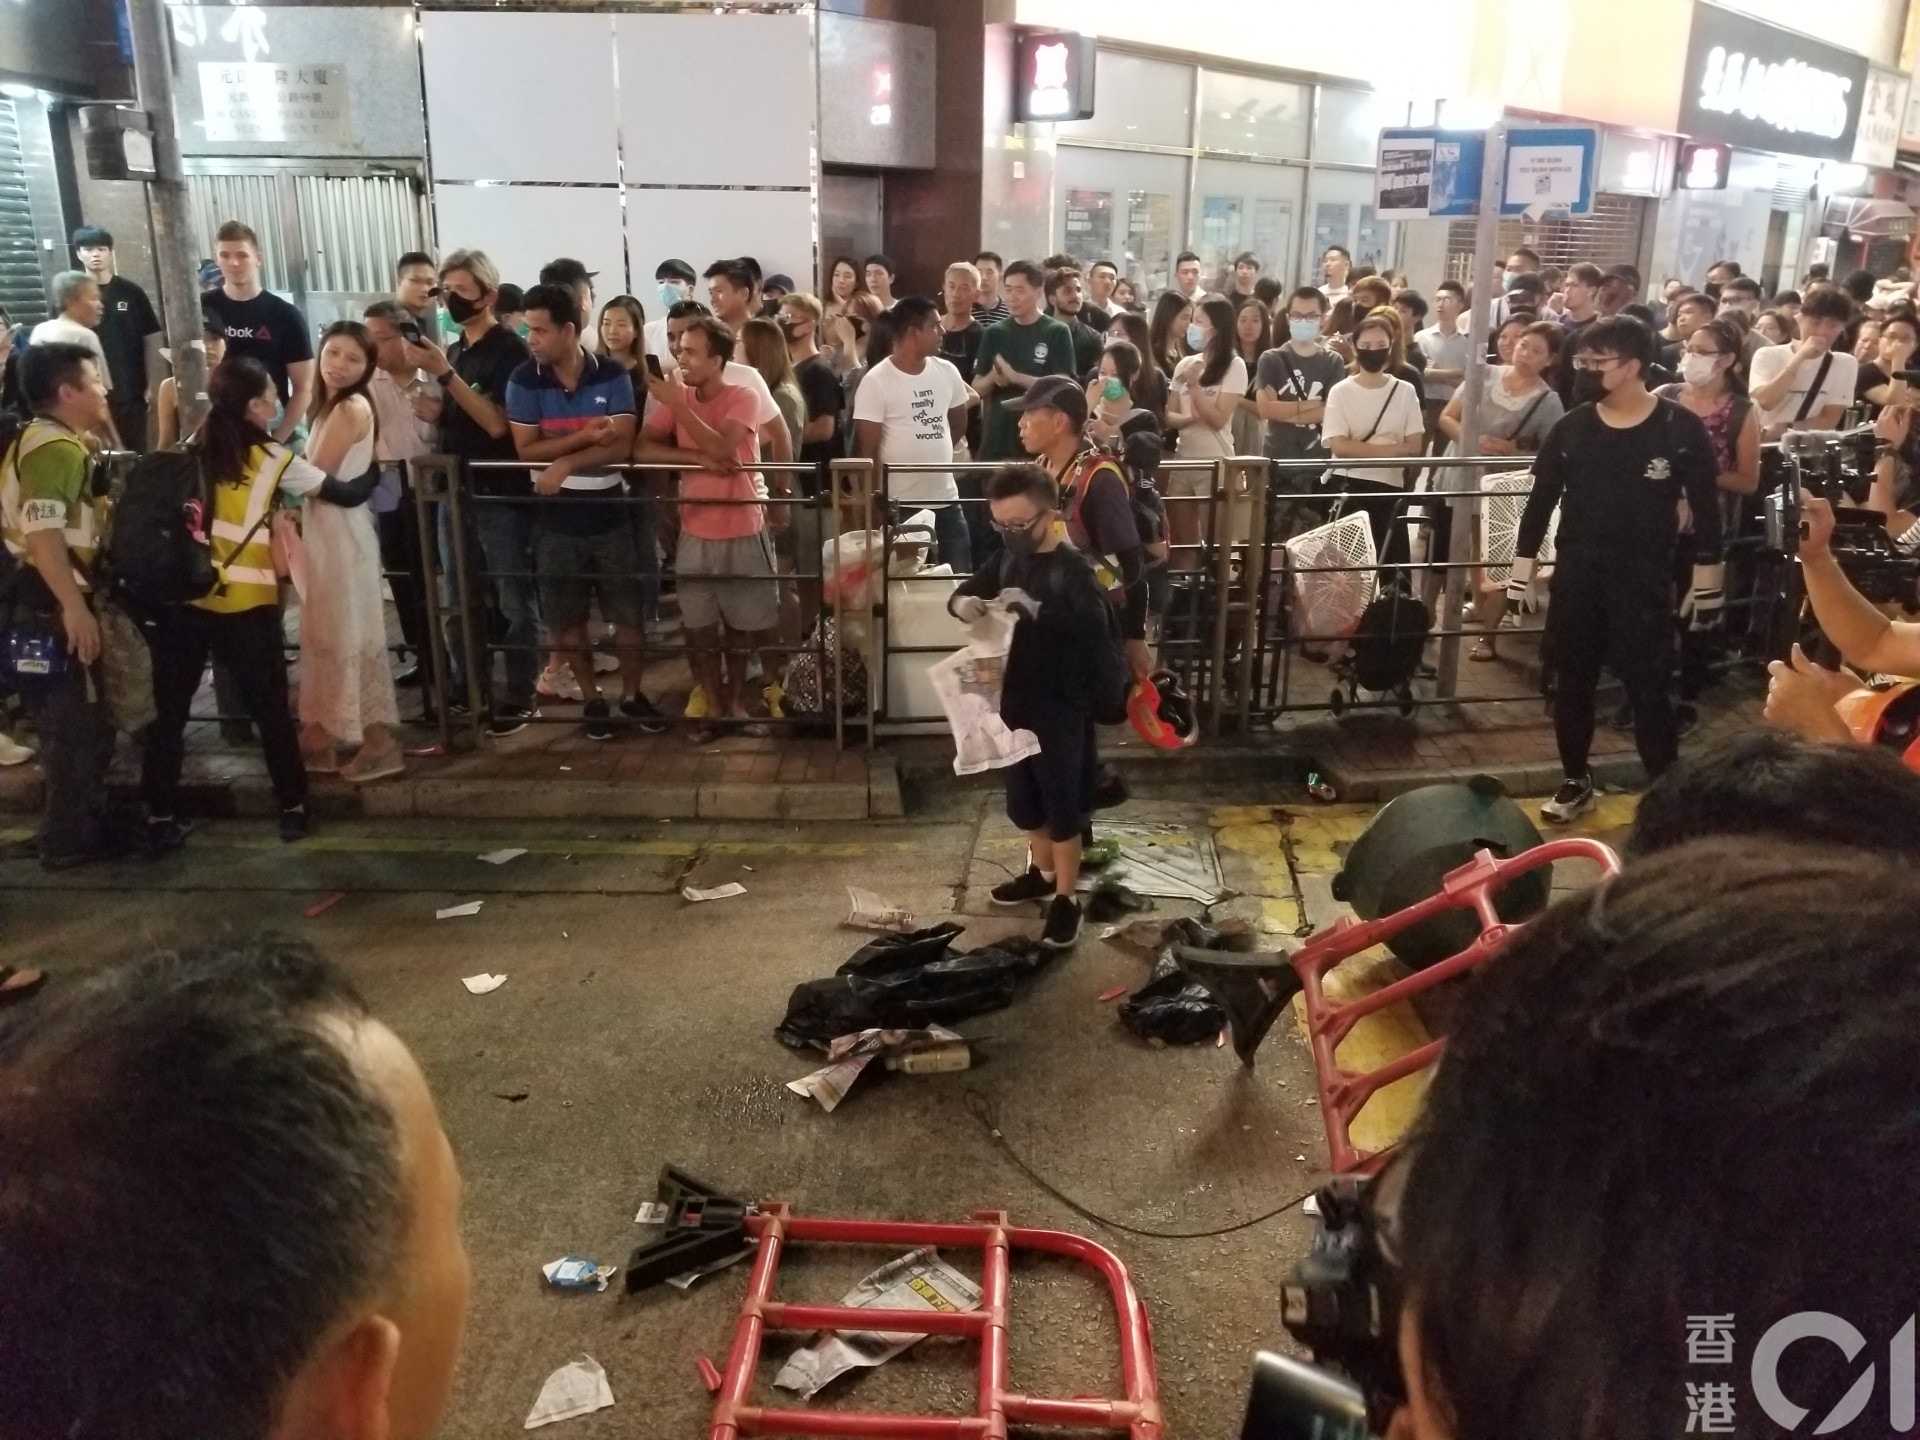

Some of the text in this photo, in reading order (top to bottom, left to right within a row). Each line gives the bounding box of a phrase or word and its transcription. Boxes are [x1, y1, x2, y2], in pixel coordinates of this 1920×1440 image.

[918, 389, 934, 398] am
[911, 398, 935, 409] really
[912, 409, 928, 422] not
[920, 413, 943, 427] good
